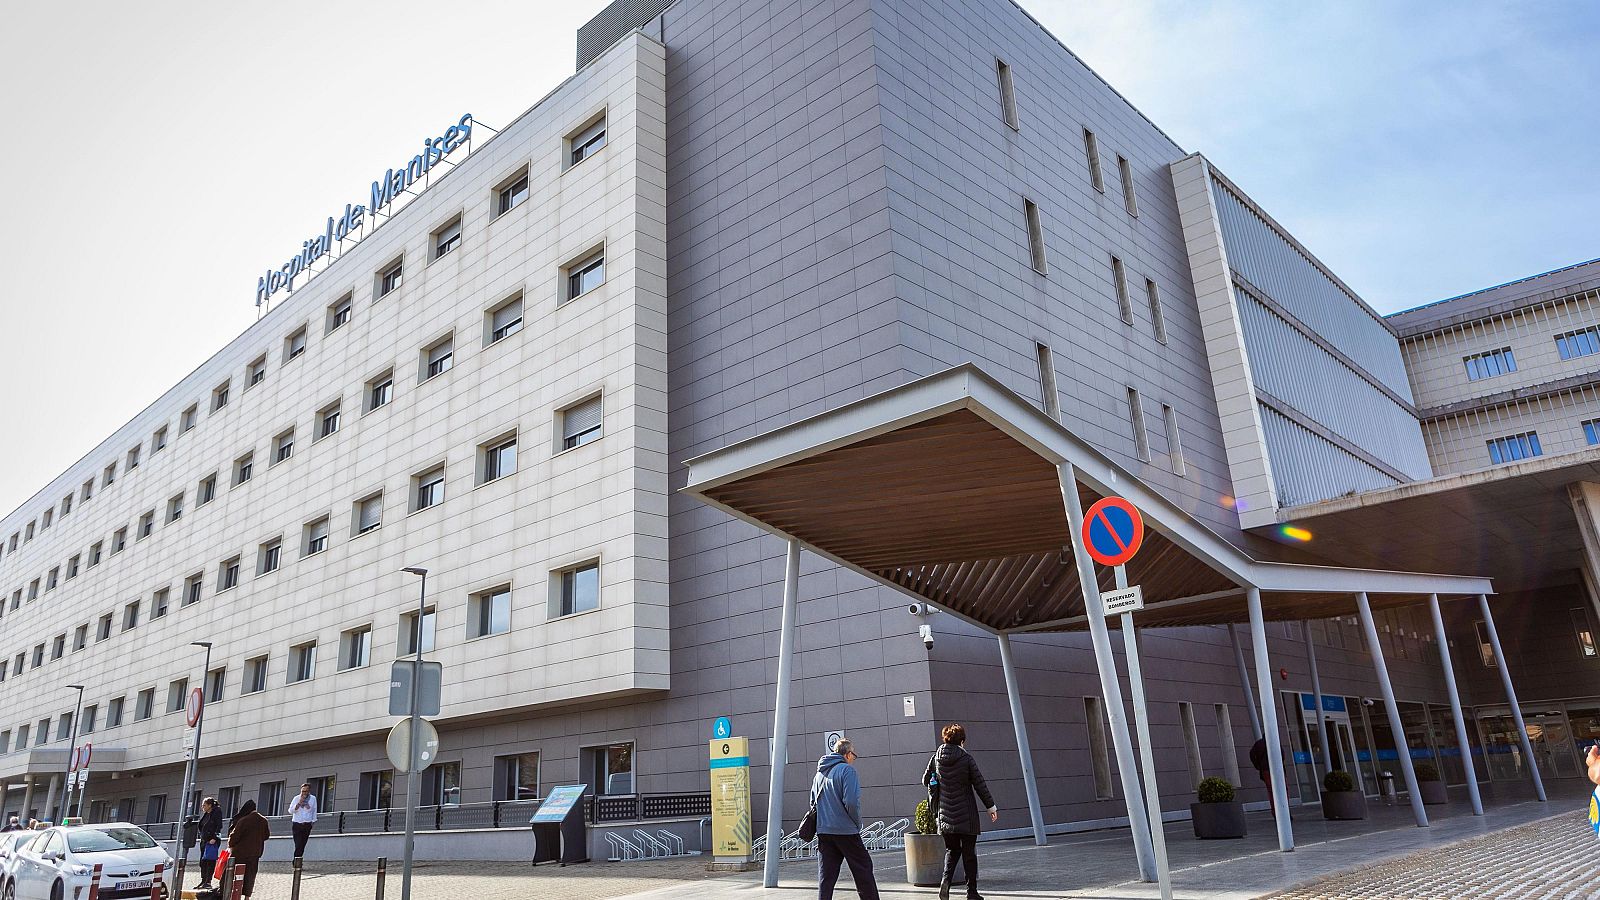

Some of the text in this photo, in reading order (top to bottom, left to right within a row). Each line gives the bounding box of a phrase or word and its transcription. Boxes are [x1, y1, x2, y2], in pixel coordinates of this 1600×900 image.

[255, 113, 472, 306] Hospital de Manises
[1106, 593, 1134, 602] RESERVADO
